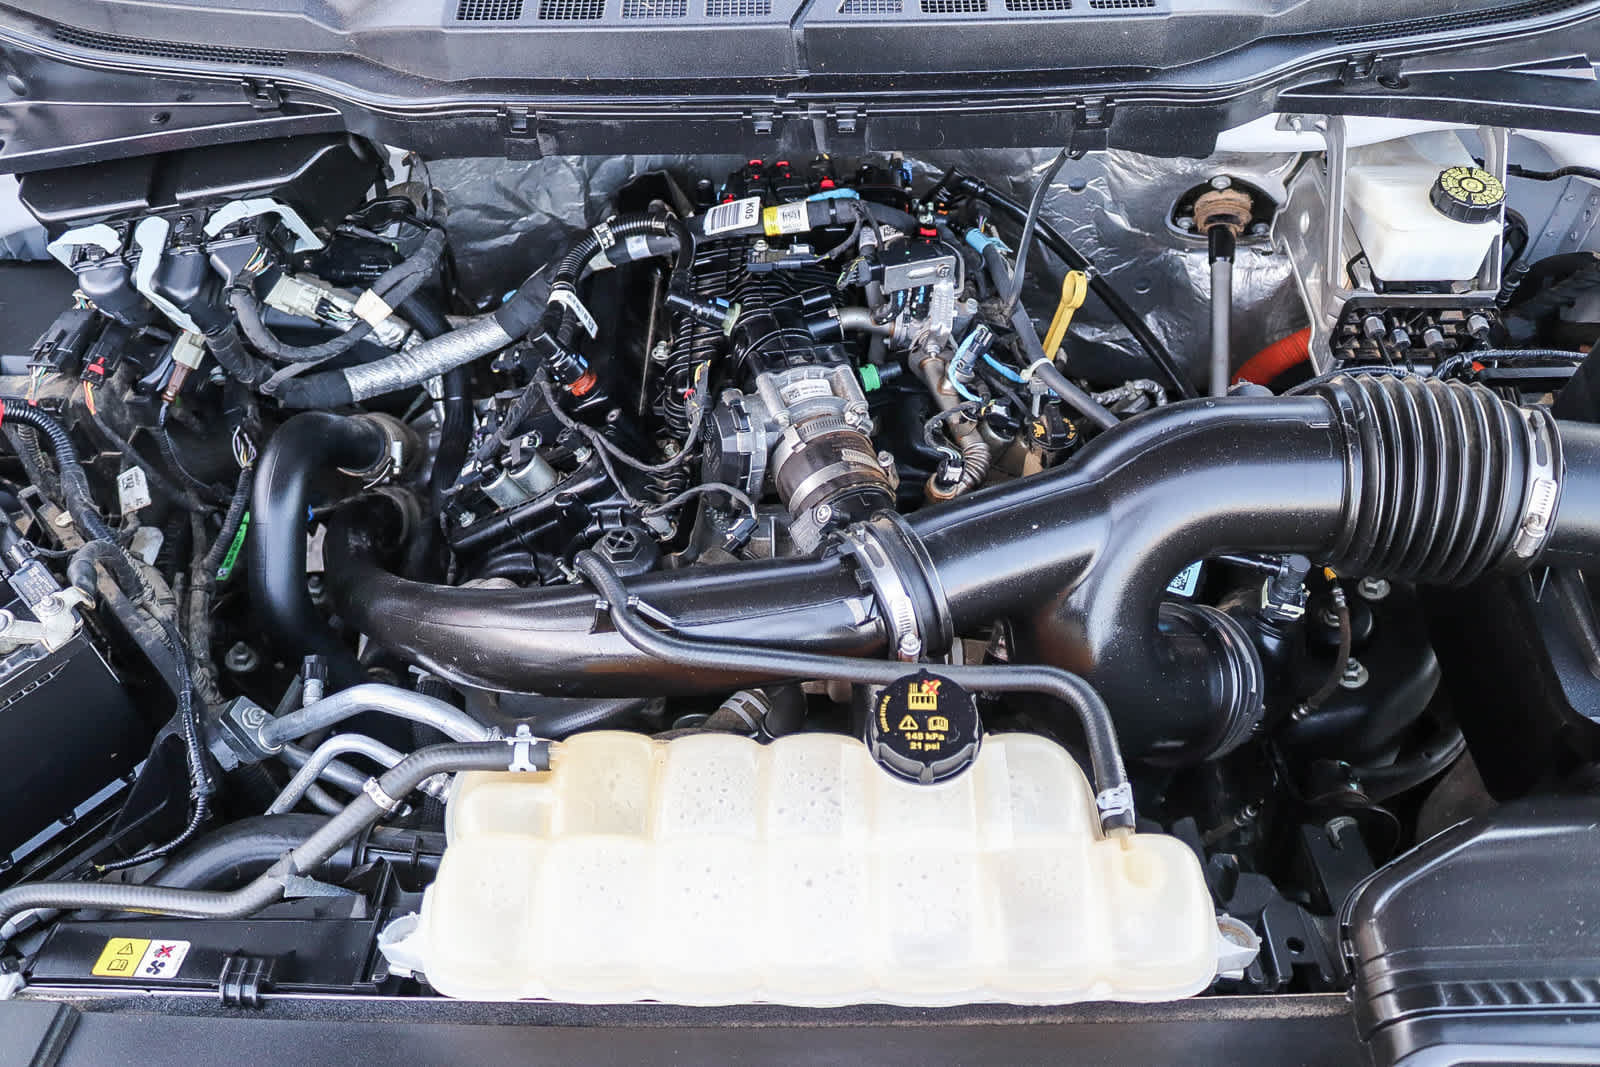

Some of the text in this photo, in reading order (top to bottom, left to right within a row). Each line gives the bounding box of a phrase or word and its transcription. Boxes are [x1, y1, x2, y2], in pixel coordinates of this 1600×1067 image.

[745, 202, 755, 220] K05
[925, 731, 945, 741] kPa
[909, 741, 940, 752] 21 psi
